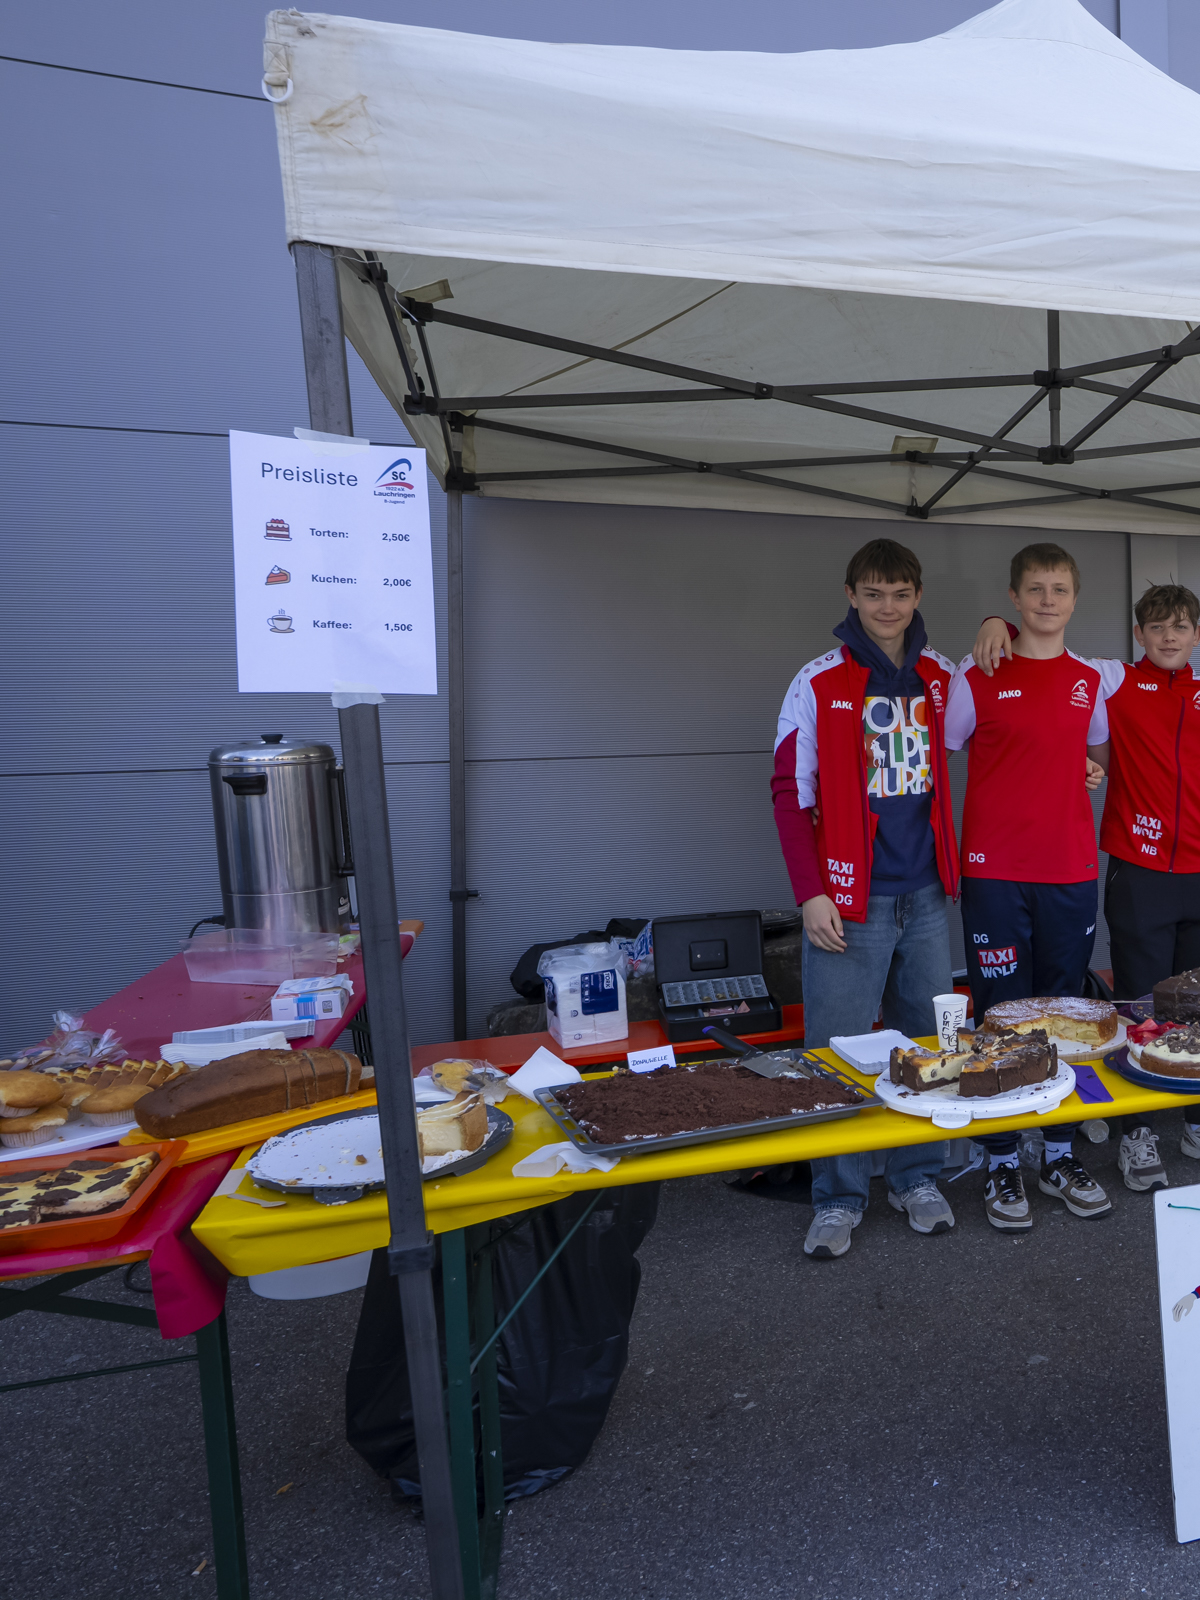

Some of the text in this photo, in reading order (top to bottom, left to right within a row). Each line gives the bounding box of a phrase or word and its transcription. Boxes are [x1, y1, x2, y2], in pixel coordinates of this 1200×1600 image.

[261, 462, 358, 487] Preisliste
[391, 471, 406, 481] SC
[373, 490, 416, 499] Lauchringen
[309, 528, 410, 542] Torten: 2,50€
[311, 574, 412, 588] Kuchen: 2,00€
[312, 620, 413, 633] Kaffee: 1,50€
[998, 690, 1022, 700] JAKO
[1136, 814, 1162, 830] TAXI
[1132, 824, 1163, 840] WOLF
[1140, 844, 1158, 856] NB
[968, 852, 986, 864] DG
[827, 858, 854, 874] TAXI
[835, 893, 853, 906] DG
[973, 934, 990, 944] DG
[979, 948, 1014, 964] TAXI
[980, 962, 1018, 979] WOLF
[942, 1010, 952, 1040] GELD
